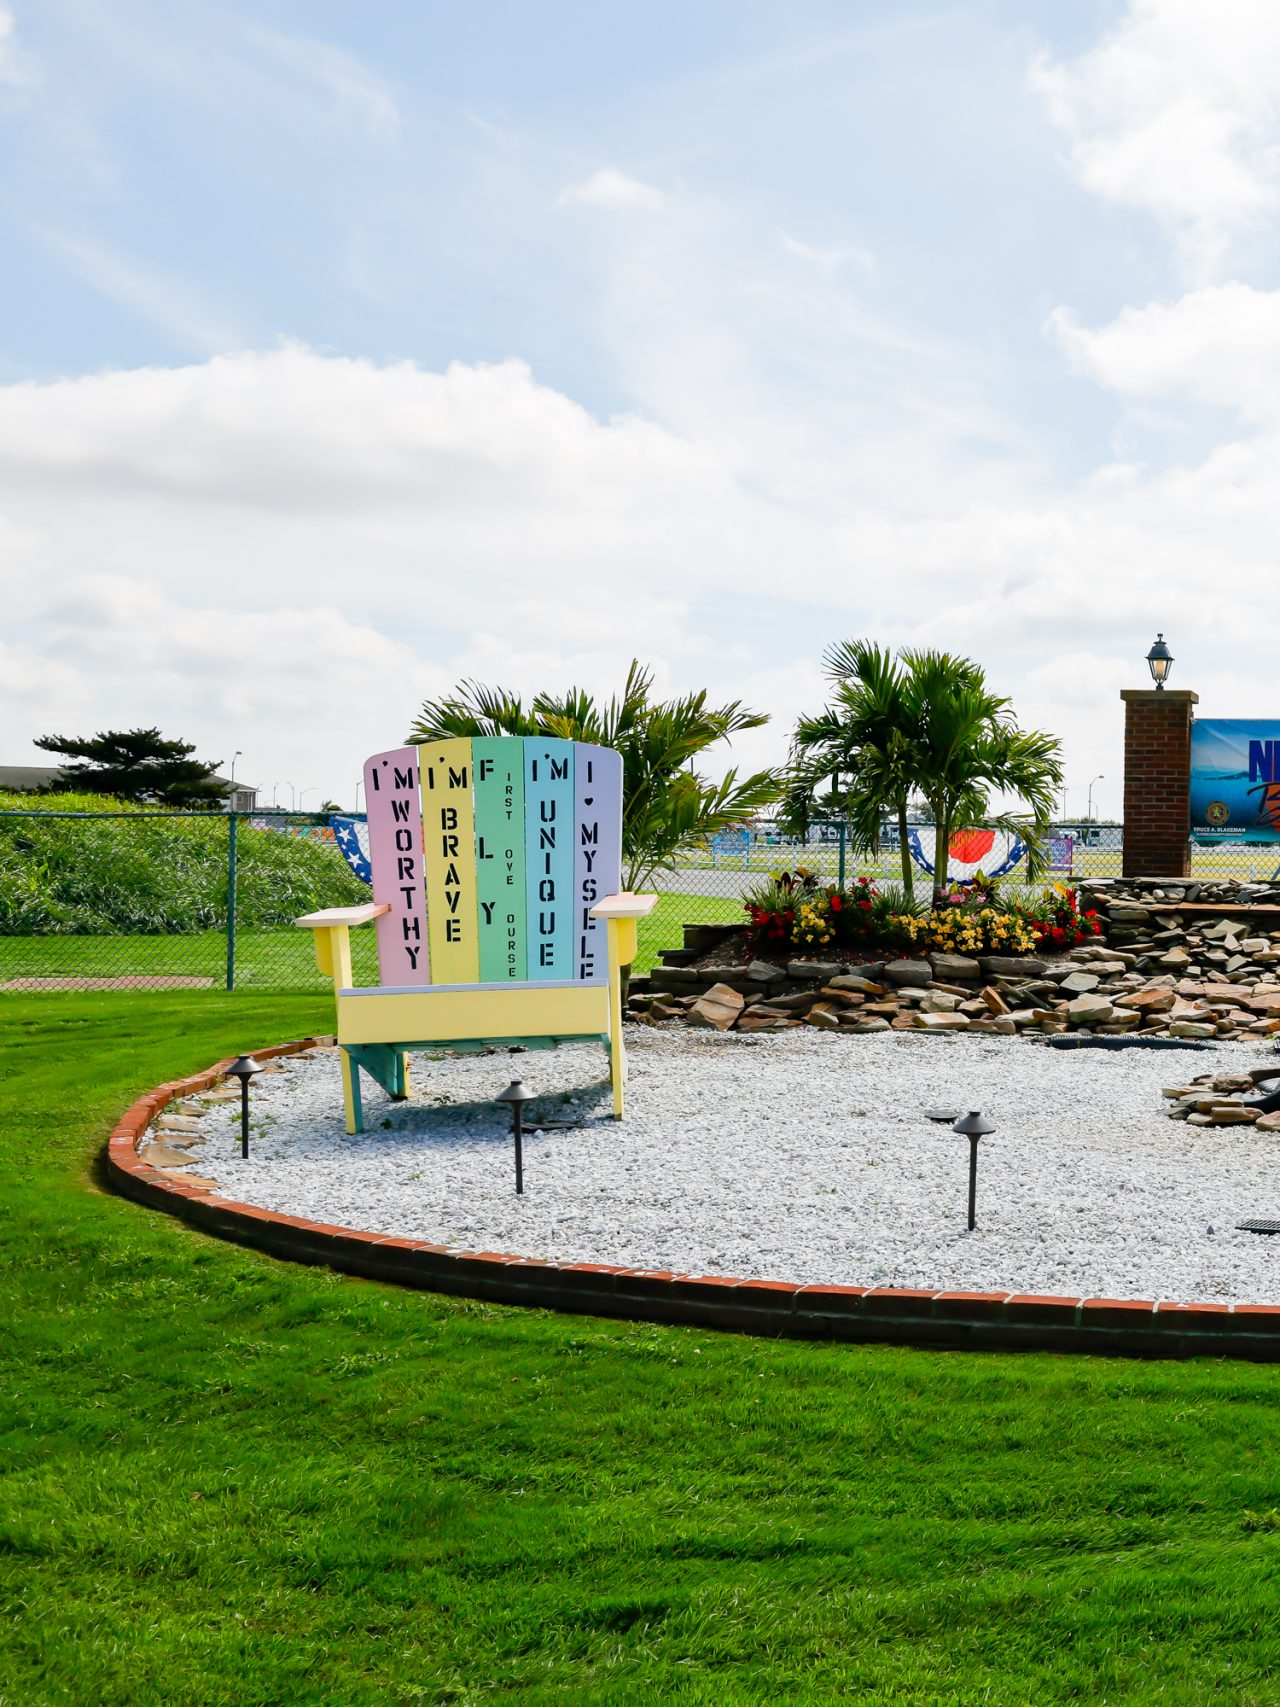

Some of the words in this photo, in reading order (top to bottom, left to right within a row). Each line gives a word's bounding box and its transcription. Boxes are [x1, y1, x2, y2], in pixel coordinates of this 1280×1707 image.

[372, 760, 414, 791] I'M
[428, 757, 468, 789] I'M
[532, 753, 569, 782] I'M
[587, 761, 593, 783] I
[391, 800, 421, 970] WORTHY
[441, 807, 461, 942] BRAVE
[539, 800, 556, 966] UNIQUE
